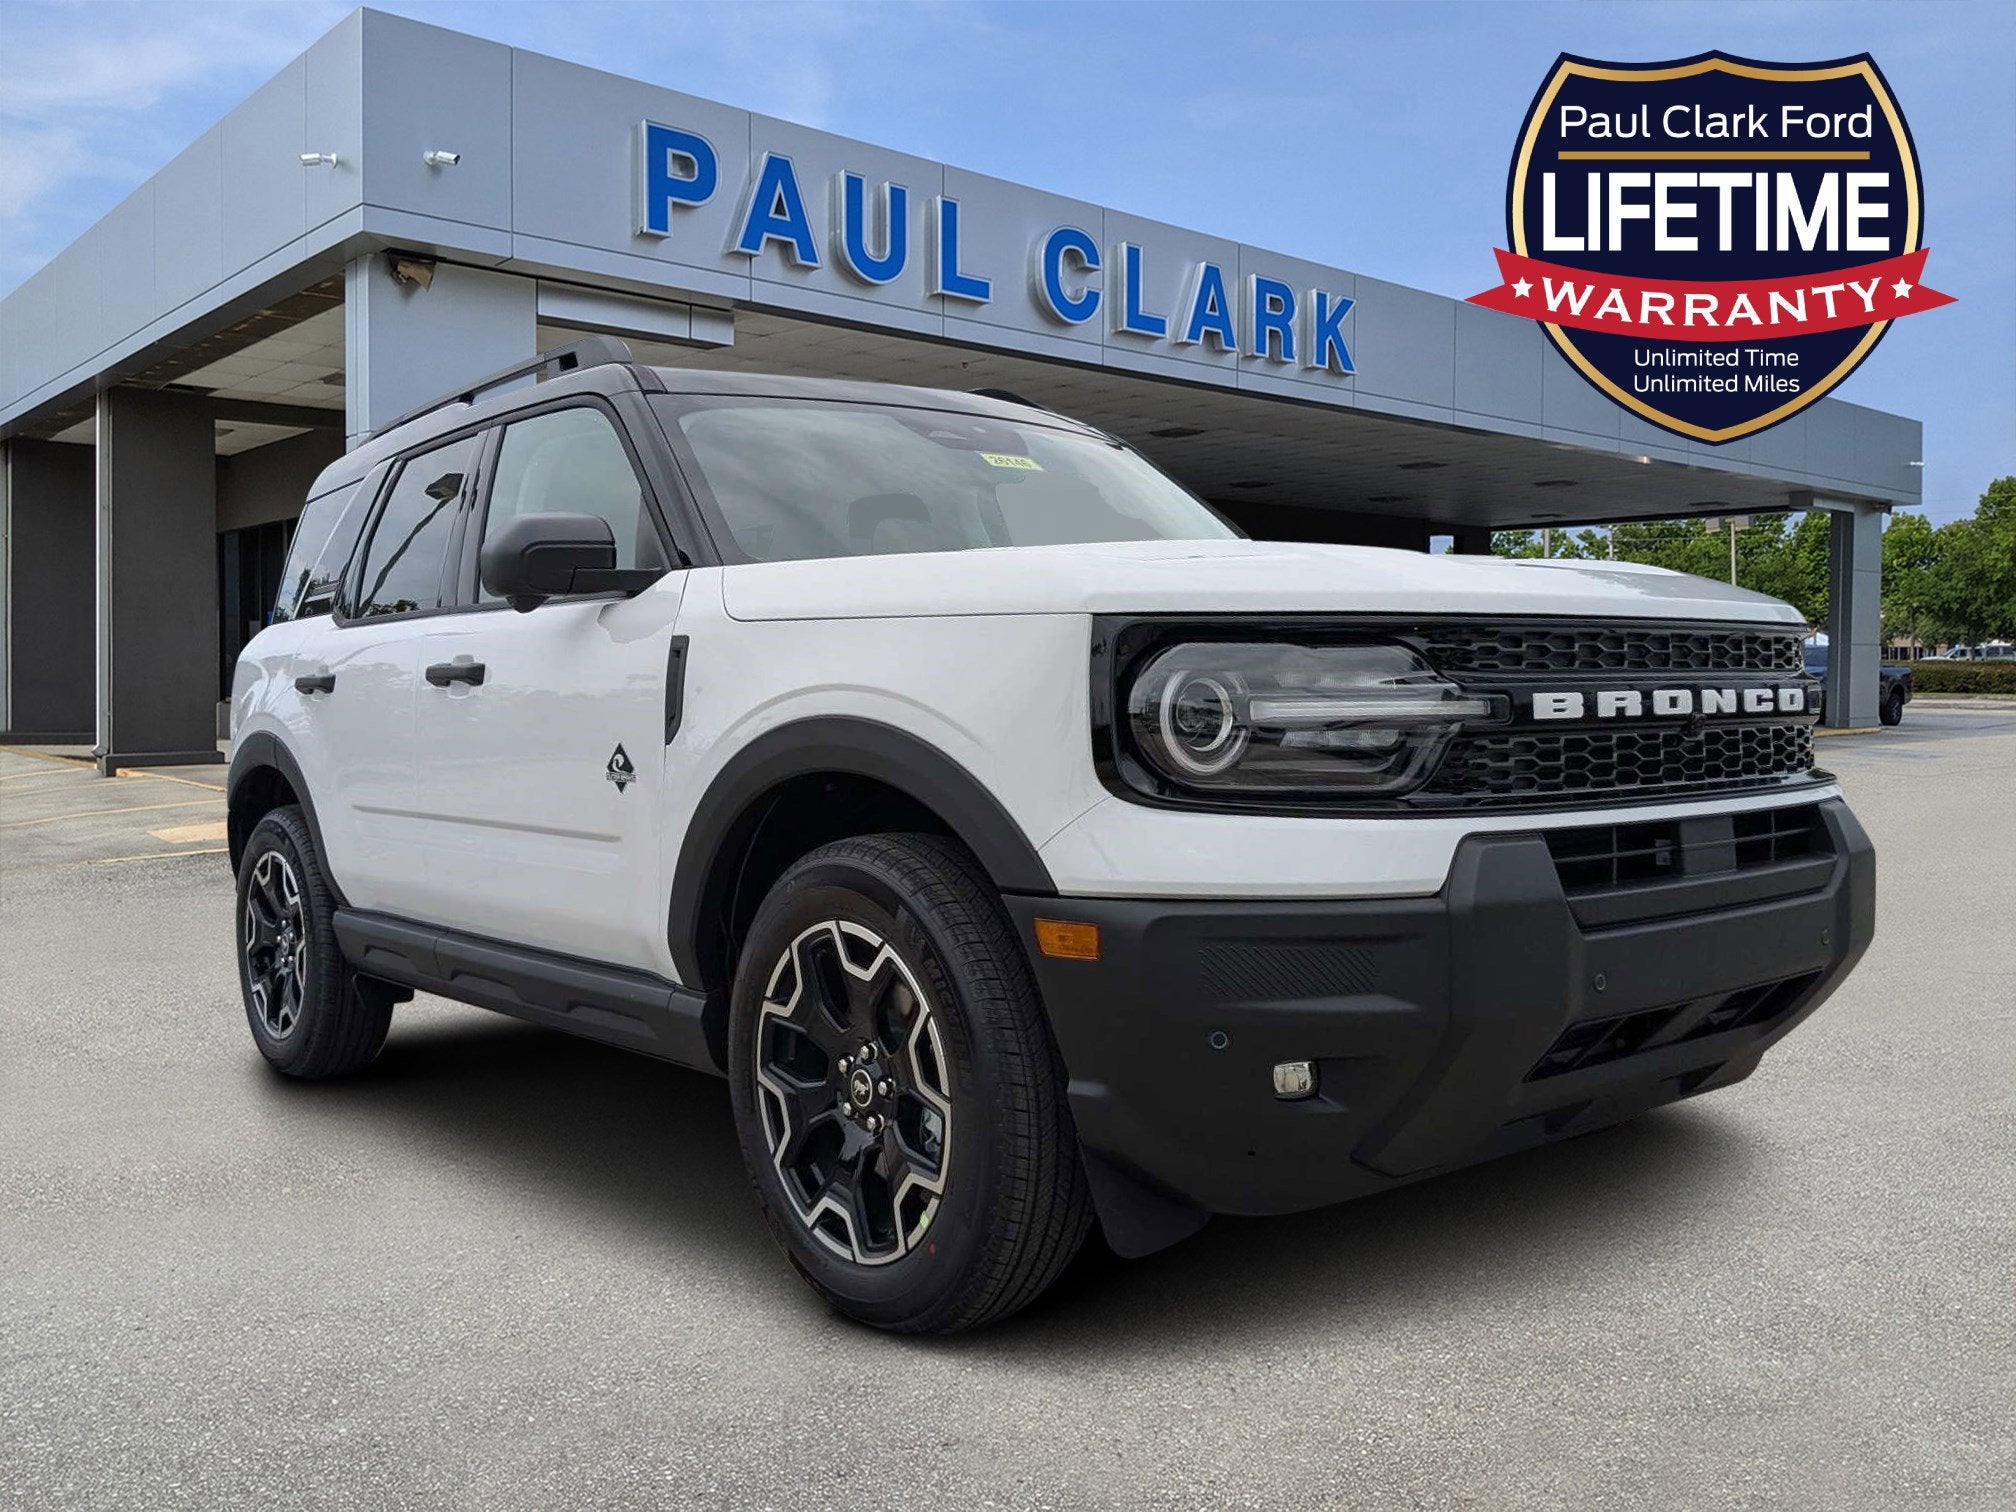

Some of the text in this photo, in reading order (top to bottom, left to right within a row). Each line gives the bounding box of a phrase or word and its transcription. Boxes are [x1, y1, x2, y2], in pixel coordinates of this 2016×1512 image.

[638, 118, 1358, 375] PAUL CLARK
[1532, 688, 1805, 720] BRONCO
